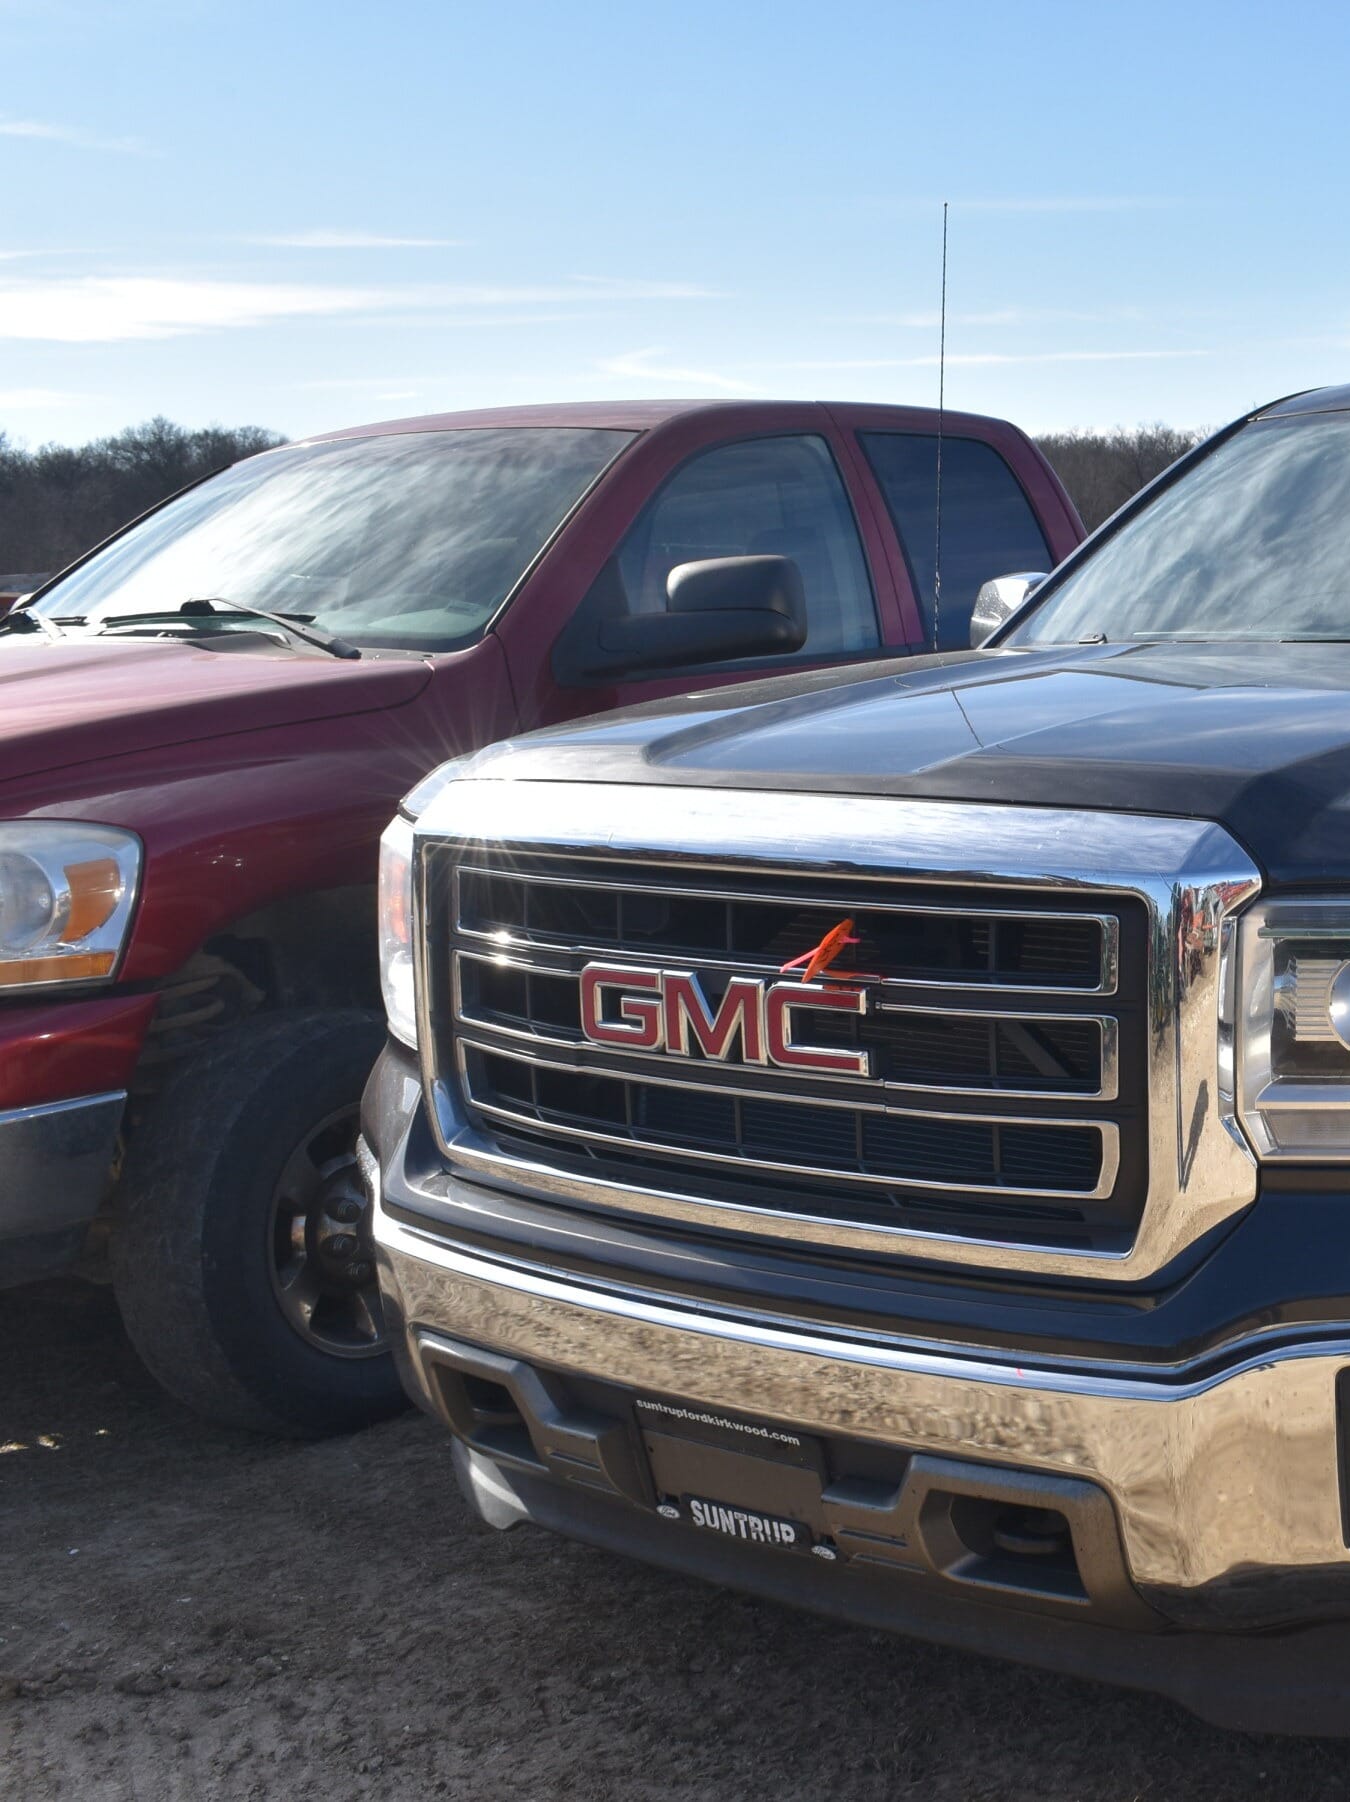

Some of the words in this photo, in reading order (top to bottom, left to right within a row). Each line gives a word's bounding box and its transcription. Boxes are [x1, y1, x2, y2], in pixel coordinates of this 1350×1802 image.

[580, 961, 870, 1077] GMC
[637, 1400, 801, 1446] suntrupfordkirkwood.com
[690, 1500, 796, 1544] SUNTRUP
